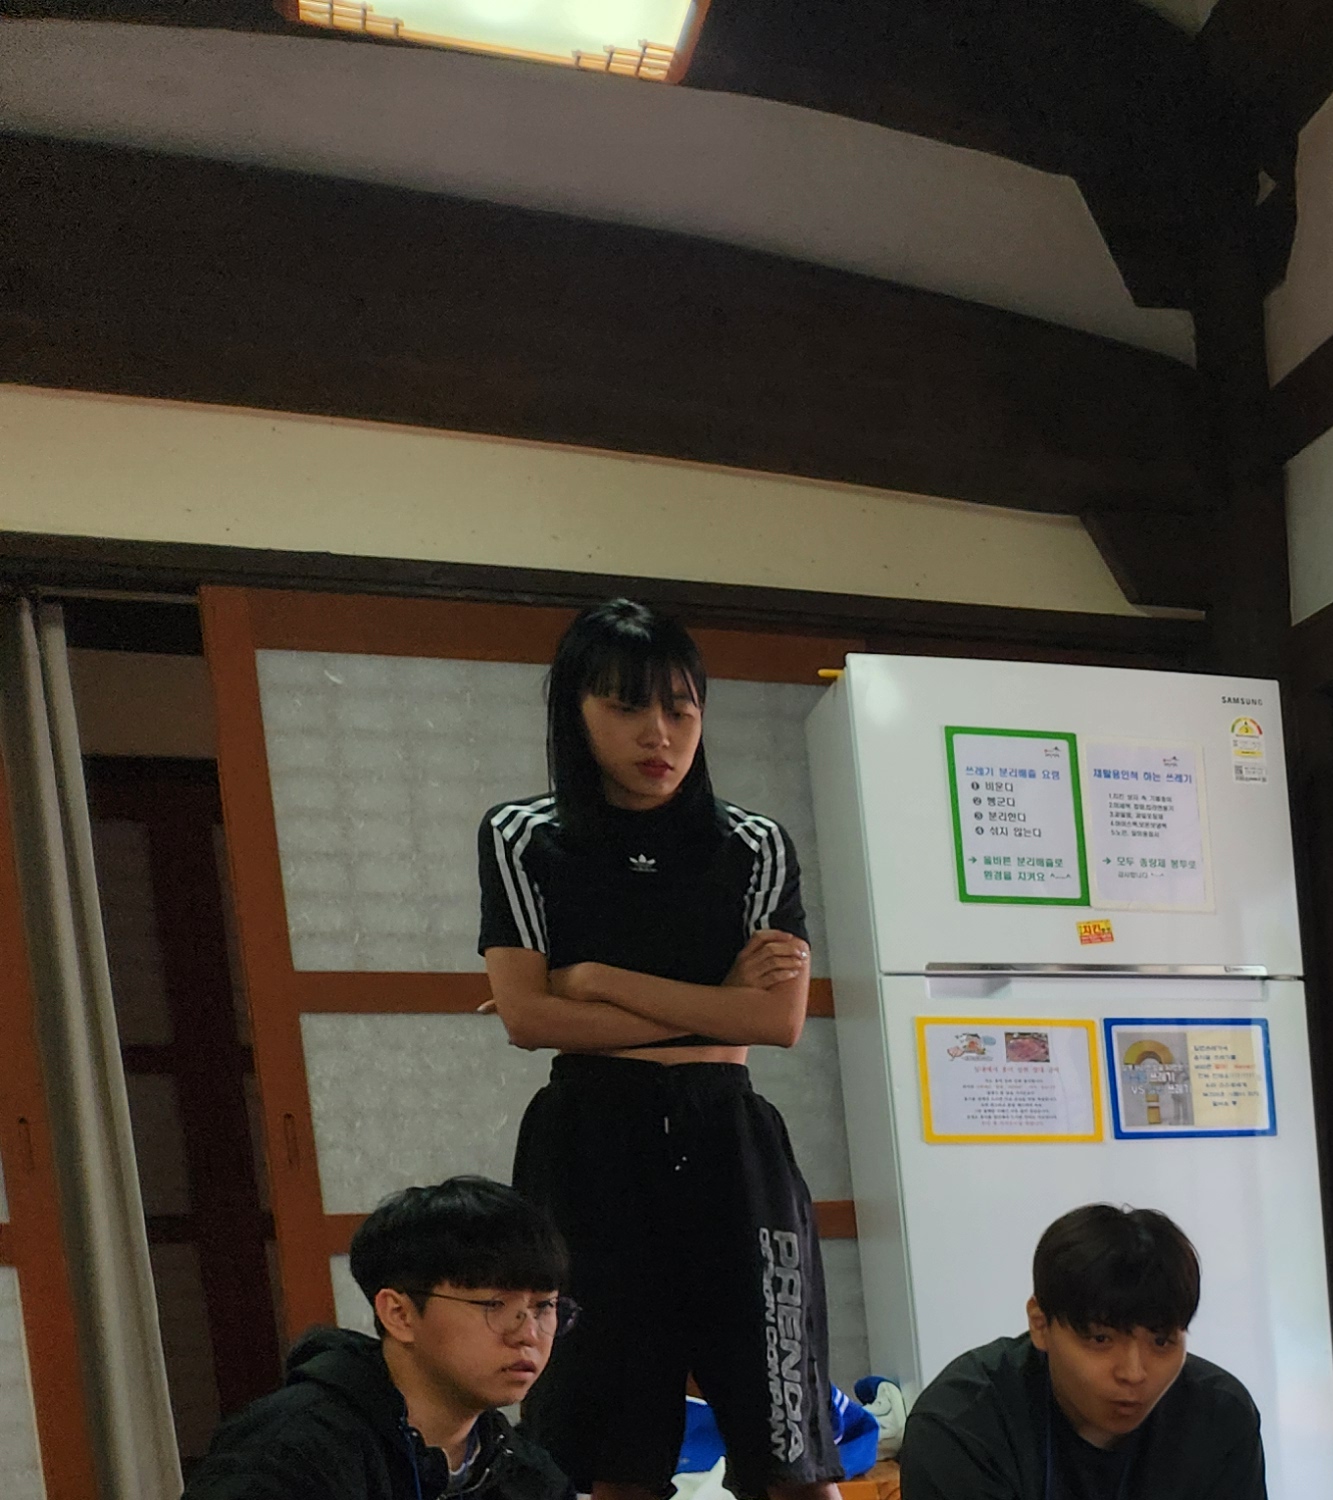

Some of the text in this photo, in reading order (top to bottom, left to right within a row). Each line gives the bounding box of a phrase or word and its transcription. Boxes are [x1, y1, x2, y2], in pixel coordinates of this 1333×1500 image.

[1221, 696, 1263, 706] SAMSUNG
[965, 766, 994, 777] 쓰레기
[999, 767, 1037, 779] 분리배출
[1143, 771, 1161, 782] 하는
[1166, 774, 1192, 784] 쓰레기
[985, 781, 1014, 792] 비운다
[988, 811, 1027, 823] 분리한다
[990, 826, 1009, 837] 섞지
[1013, 827, 1042, 838] 않는다
[983, 856, 1064, 868] 올바른 분리배출로
[1117, 857, 1134, 866] 모두
[1140, 858, 1166, 868] 종량제
[983, 870, 1012, 881] 환경을
[1017, 872, 1045, 882] 지켜요
[1131, 1086, 1145, 1094] VS
[766, 1326, 786, 1462] COMPANY
